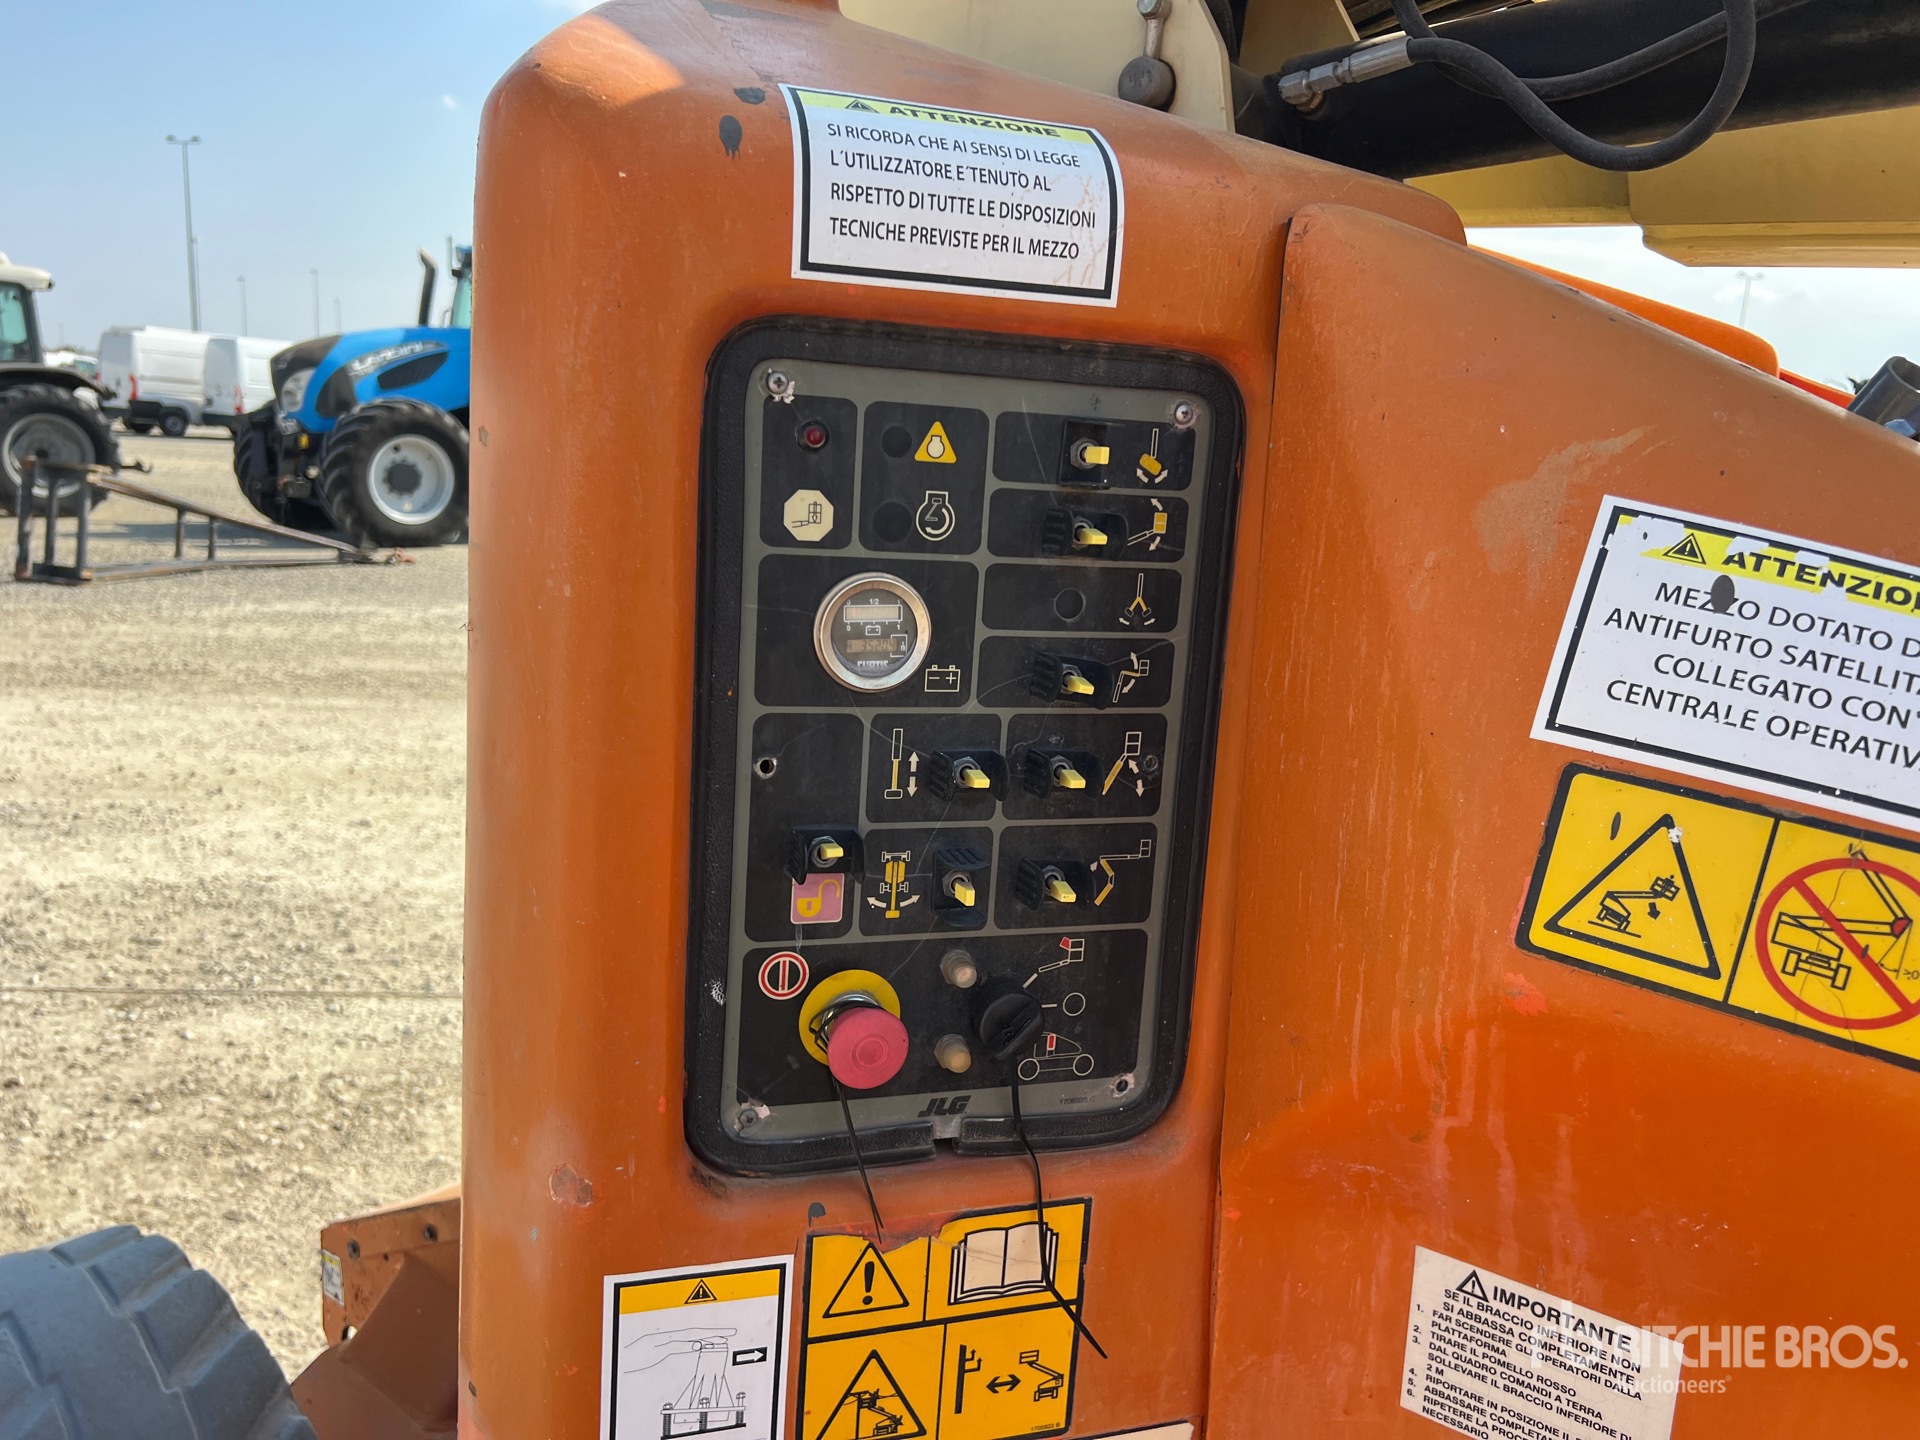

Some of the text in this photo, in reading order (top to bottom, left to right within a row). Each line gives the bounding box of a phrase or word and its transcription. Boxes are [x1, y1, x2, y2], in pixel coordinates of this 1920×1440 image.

[827, 123, 1081, 168] SI RICORDA CHE AI SENSI DI LEGGE
[889, 106, 1061, 138] ATTENZIONE
[831, 182, 1096, 229] RISPETTO DI TUTTE LE DISPOSIZIONI
[1033, 175, 1051, 192] AL
[829, 217, 1080, 260] TECNICHE PREVISTE PER IL MEZZO
[1721, 551, 1920, 612] ATTENZIO
[1603, 607, 1920, 696] ANTIFURTO SATELLIT
[1769, 606, 1893, 651] DOTATO
[1653, 653, 1833, 710] COLLEGATO
[1606, 680, 1920, 771] CENTRALE OPERATIV
[917, 1095, 971, 1118] JLG
[1431, 1320, 1507, 1358] PLATTAFORMA
[1443, 1301, 1635, 1386] SI ABBASSA COMPLETAMENTE
[1444, 1288, 1641, 1374] SE IL BRACCIO INFERIORE NON
[1492, 1285, 1632, 1353] IMPORTANTE
[1413, 1324, 1577, 1397] 2. TIRARE IL POMELLO ROSSO
[1416, 1303, 1642, 1400] 1. FAR SCENDERE GLI OPERATORI DALLA
[1426, 1363, 1444, 1377] 2 M
[1407, 1377, 1416, 1387] 5.
[1424, 1384, 1487, 1417] ABBASSARE
[1408, 1367, 1417, 1377] 4.
[1425, 1373, 1484, 1404] RIPORTARE
[1487, 1399, 1498, 1411] IN
[1500, 1405, 1560, 1437] POSIZIONE
[1412, 1335, 1603, 1421] 3. DAL QUADRO COMANDI A TERRA
[1427, 1352, 1488, 1384] SOLLEVARE
[1490, 1378, 1500, 1389] IL
[1503, 1383, 1553, 1411] BRACCIO
[1556, 1406, 1617, 1438] INFERIORE
[1406, 1388, 1415, 1397] 6.
[1423, 1394, 1473, 1422] RIPETERE
[1475, 1417, 1489, 1429] LA
[1422, 1405, 1489, 1440] NECESSARIO
